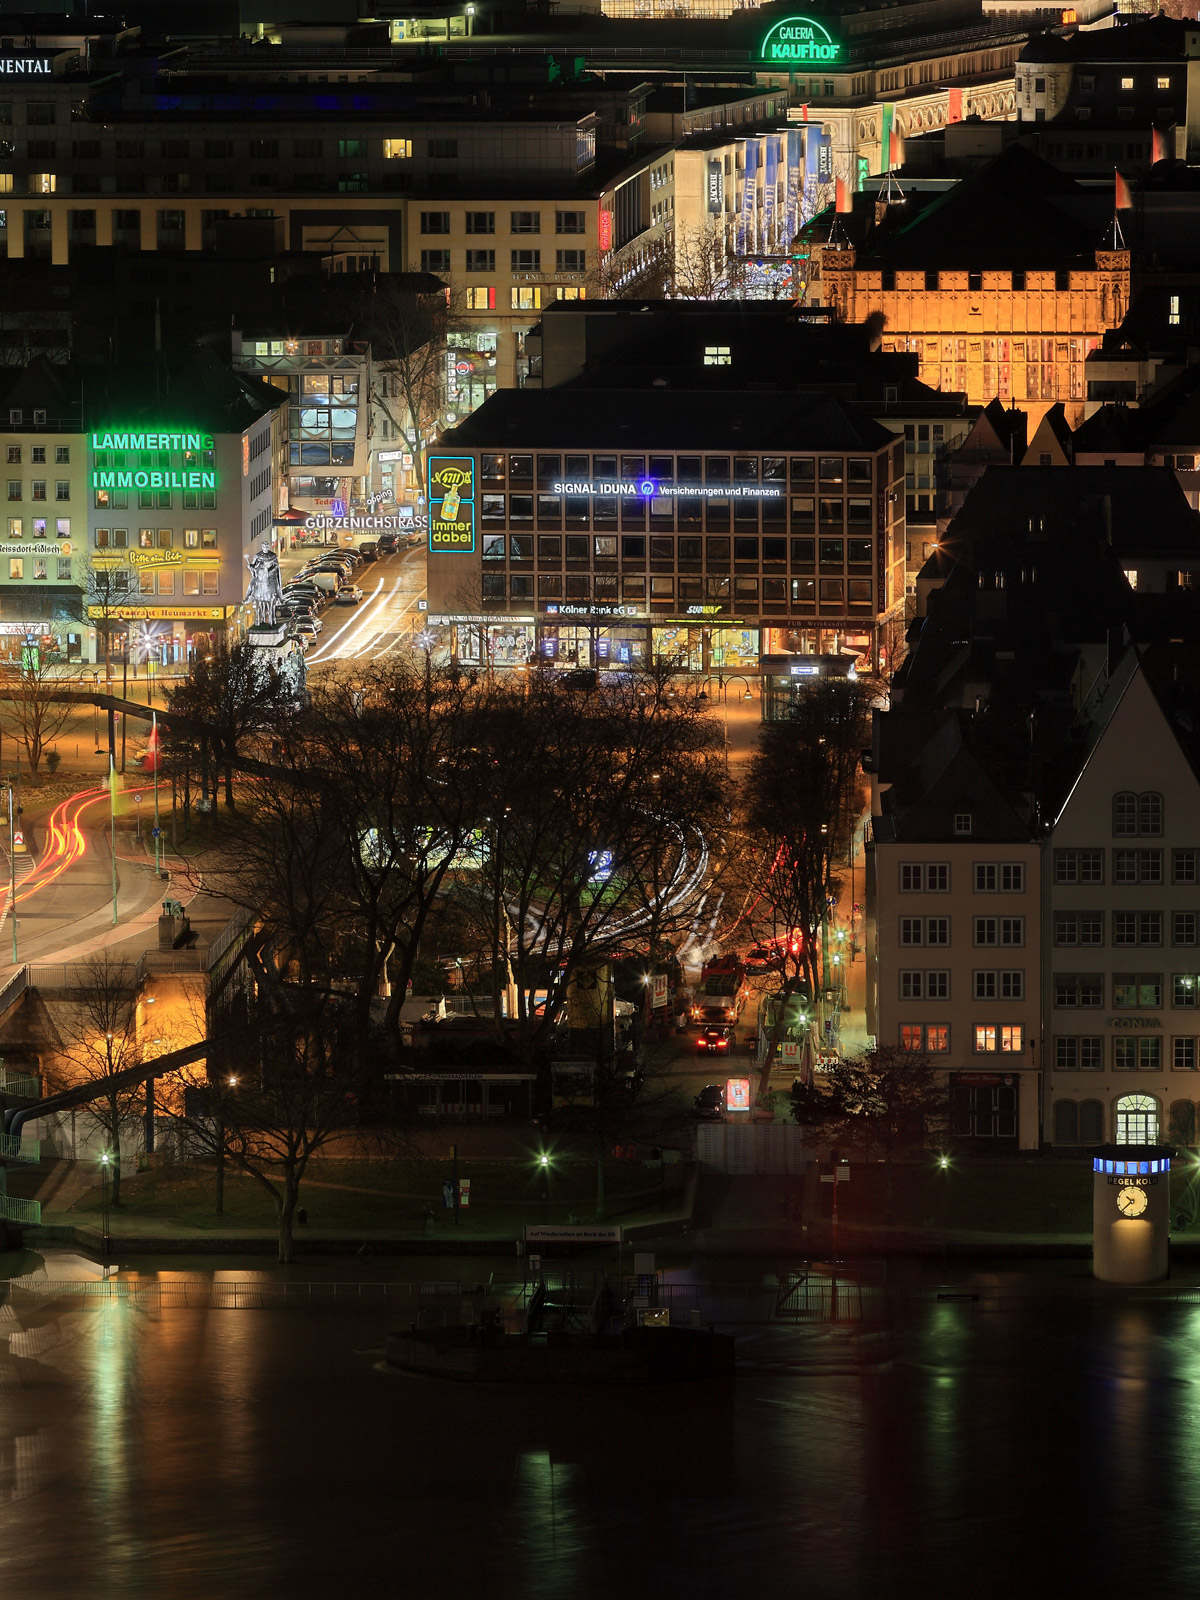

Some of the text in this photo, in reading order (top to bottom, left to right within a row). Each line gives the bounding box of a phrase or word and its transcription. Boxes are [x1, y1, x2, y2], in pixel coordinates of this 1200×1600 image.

[780, 26, 814, 39] GALERIA
[819, 145, 828, 174] JACOBI
[710, 173, 718, 202] JACOBI
[92, 433, 214, 450] LAMMERTING
[93, 471, 215, 488] IMMOBILIEN
[442, 473, 460, 483] 4711
[554, 483, 780, 496] SIGNAL IDUNA Versicherungen und Finanzen
[432, 520, 471, 531] immer
[433, 531, 471, 542] dabei
[130, 552, 149, 563] Bitte
[165, 551, 182, 561] Bit
[559, 606, 625, 614] Kölner Bank eG
[687, 606, 722, 614] SUBWAY
[1108, 1177, 1134, 1185] PEGEL
